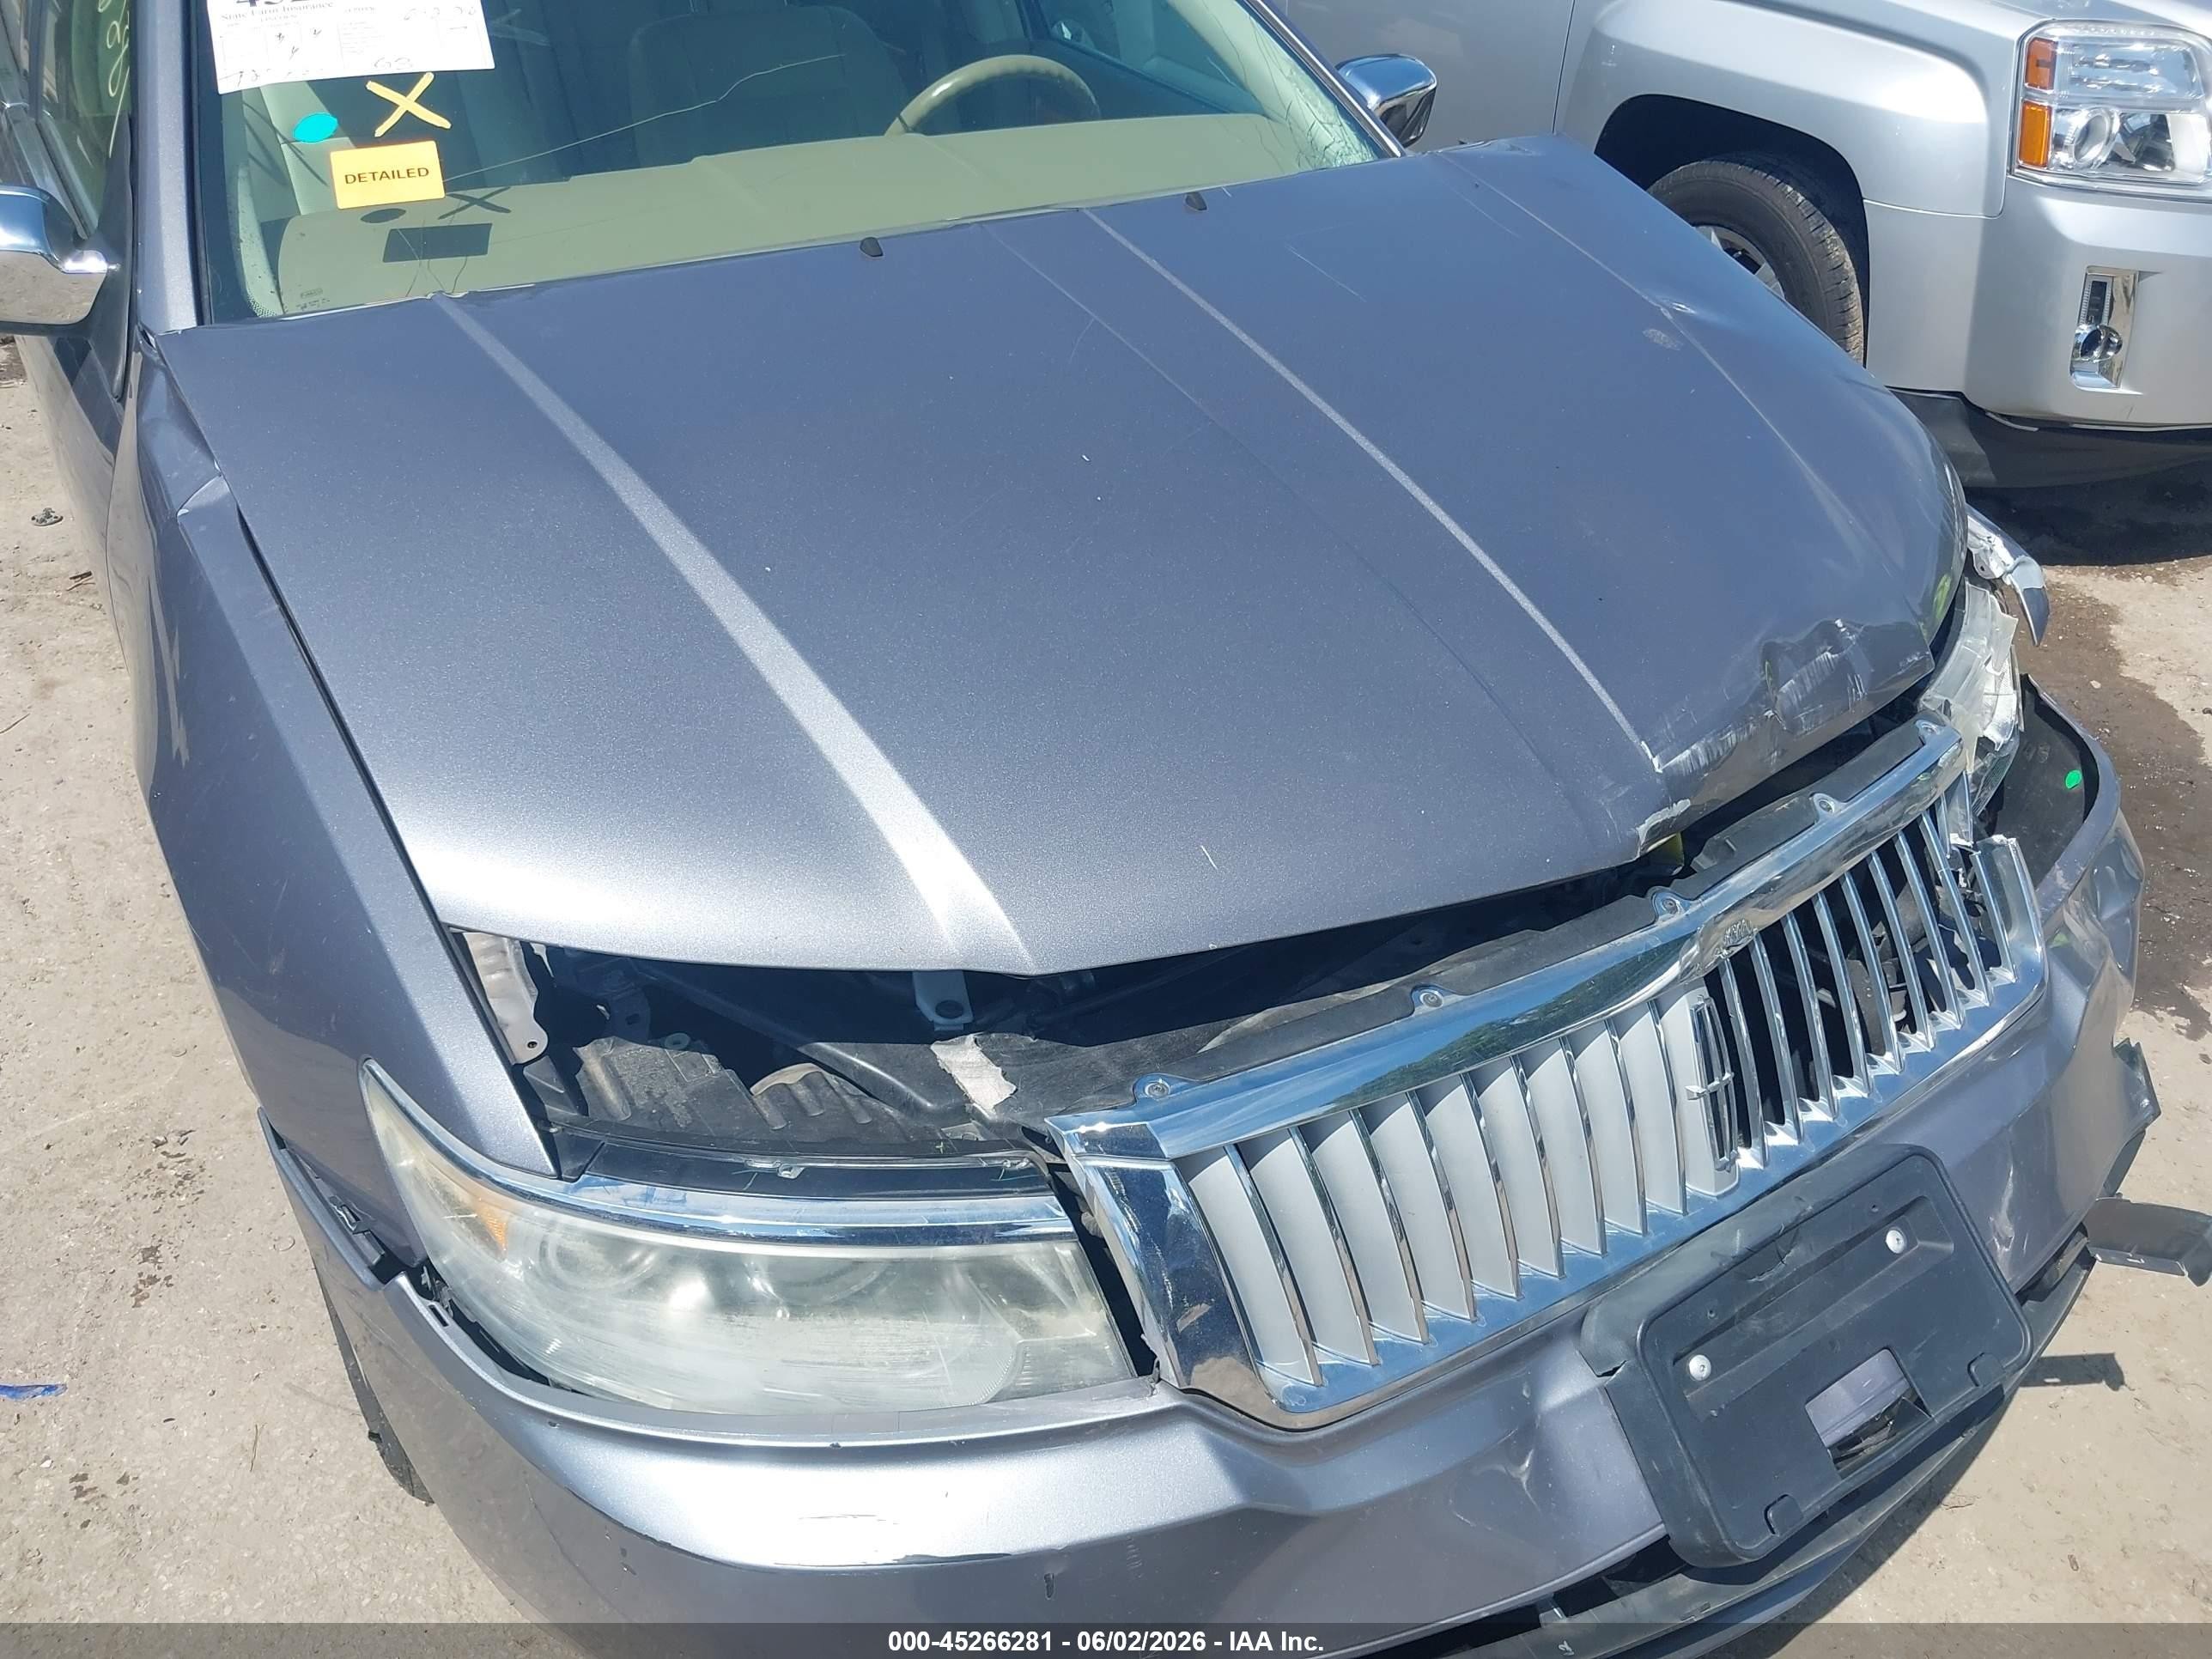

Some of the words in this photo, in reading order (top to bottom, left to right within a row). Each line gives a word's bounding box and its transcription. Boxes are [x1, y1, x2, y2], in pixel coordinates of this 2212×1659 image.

[221, 12, 247, 21] State
[251, 8, 278, 16] Farm
[283, 3, 334, 13] Insurance
[344, 167, 429, 185] DETAILED
